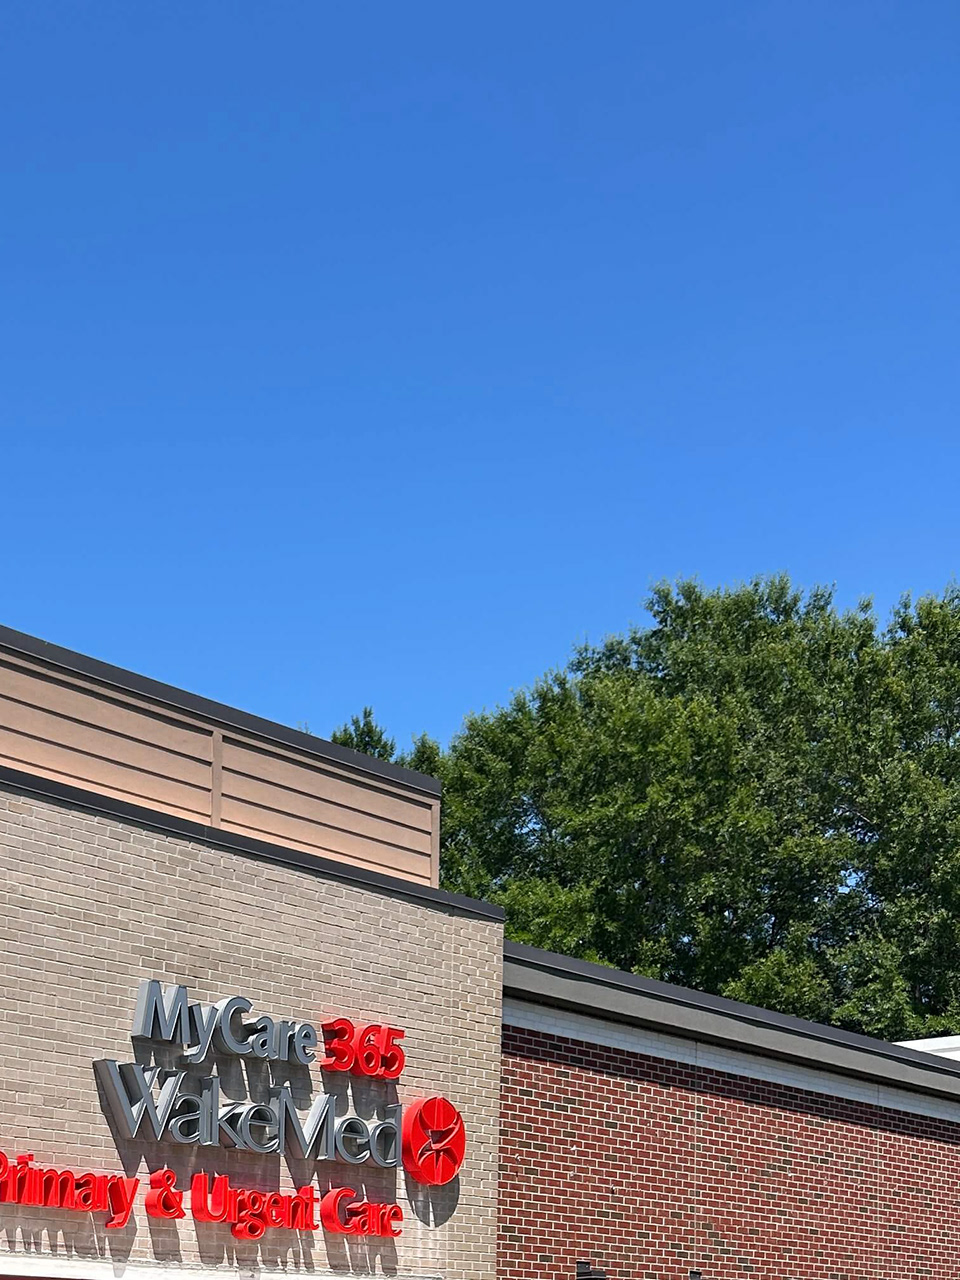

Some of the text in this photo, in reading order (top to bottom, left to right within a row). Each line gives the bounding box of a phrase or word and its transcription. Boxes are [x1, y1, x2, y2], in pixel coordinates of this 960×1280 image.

[131, 979, 405, 1080] MyCare 365
[92, 1058, 402, 1168] WakeMed
[145, 1167, 186, 1219] &
[191, 1170, 319, 1240] Urgent
[320, 1187, 403, 1238] Care
